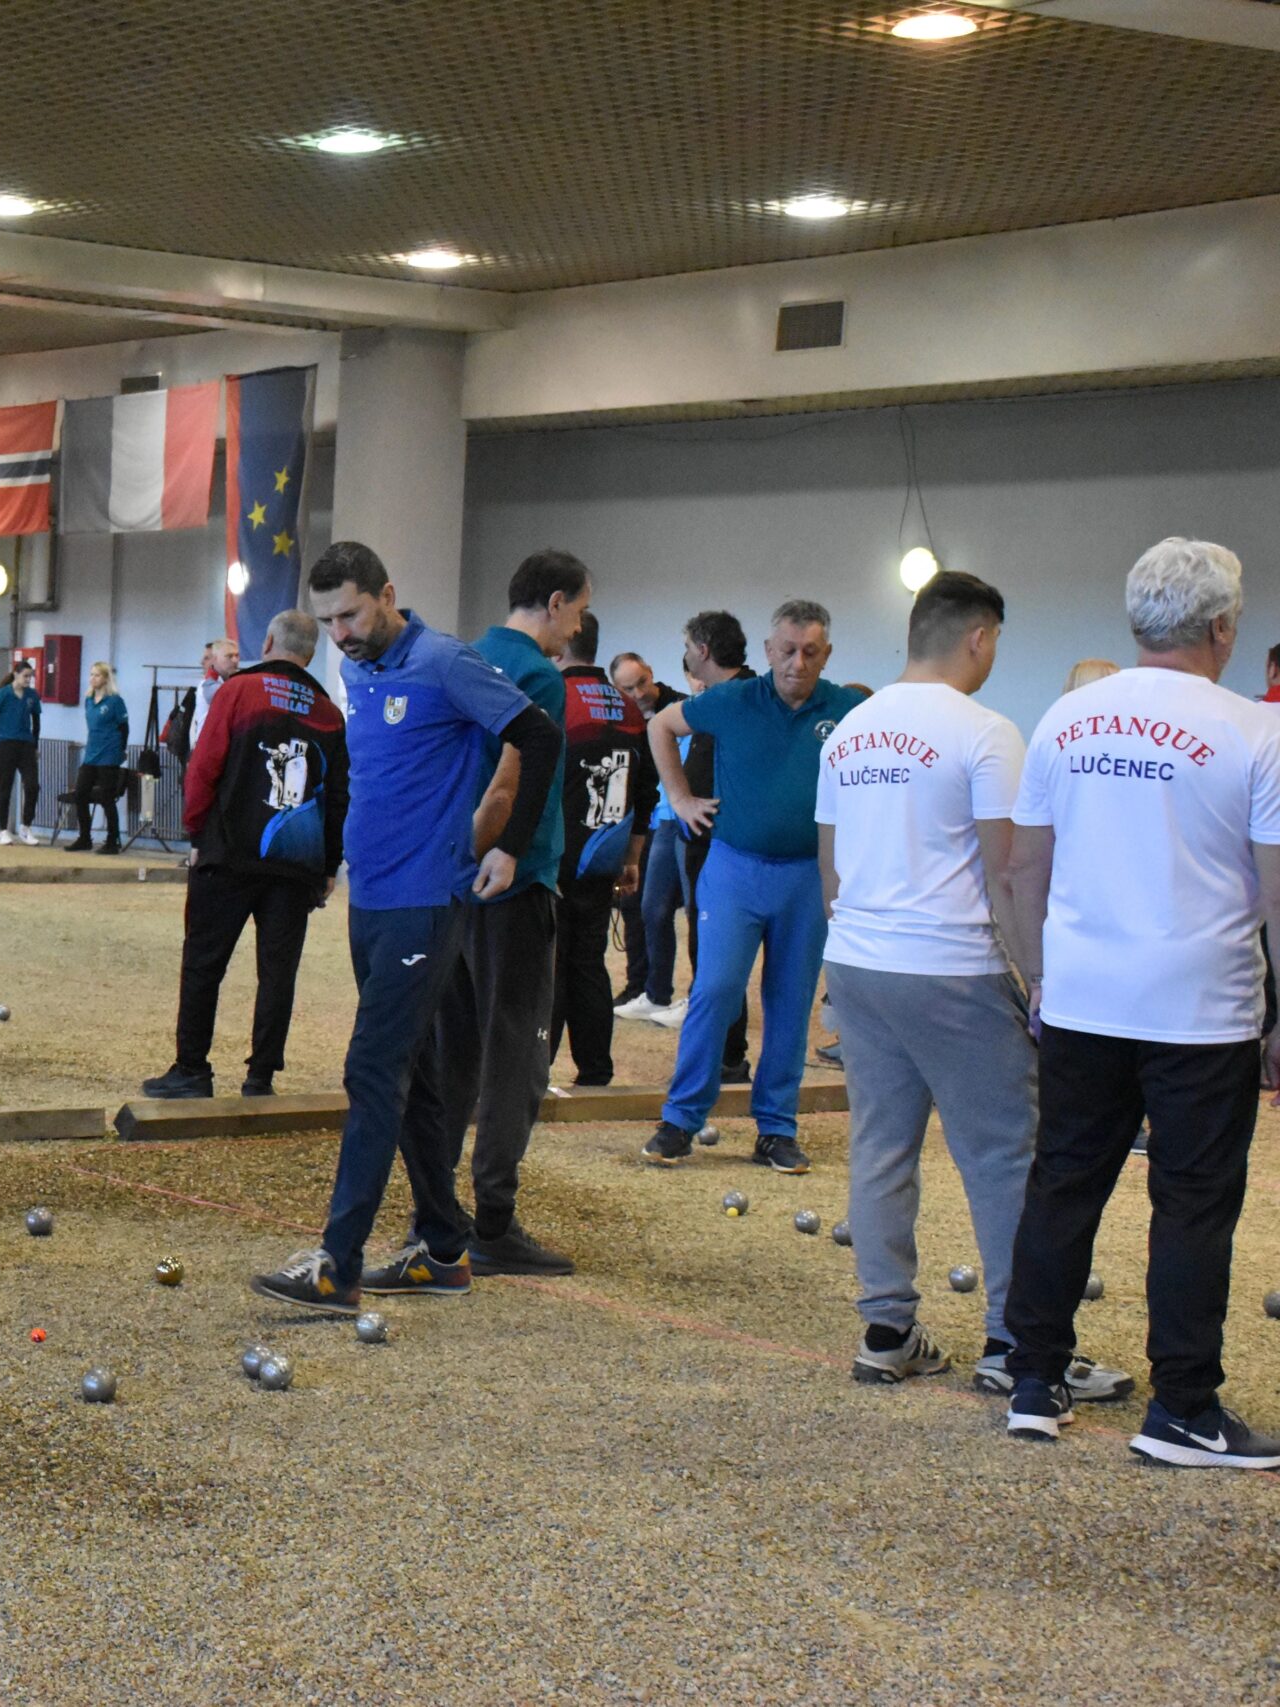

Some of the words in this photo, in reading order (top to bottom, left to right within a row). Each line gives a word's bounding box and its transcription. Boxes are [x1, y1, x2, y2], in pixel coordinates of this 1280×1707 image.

[263, 677, 315, 697] PREVEZA
[271, 694, 310, 716] HELLAS
[589, 706, 625, 721] HELLAS
[827, 731, 940, 769] PETANQUE
[1055, 715, 1216, 768] PETANQUE
[840, 765, 911, 787] LUČENEC
[1070, 752, 1176, 782] LUČENEC
